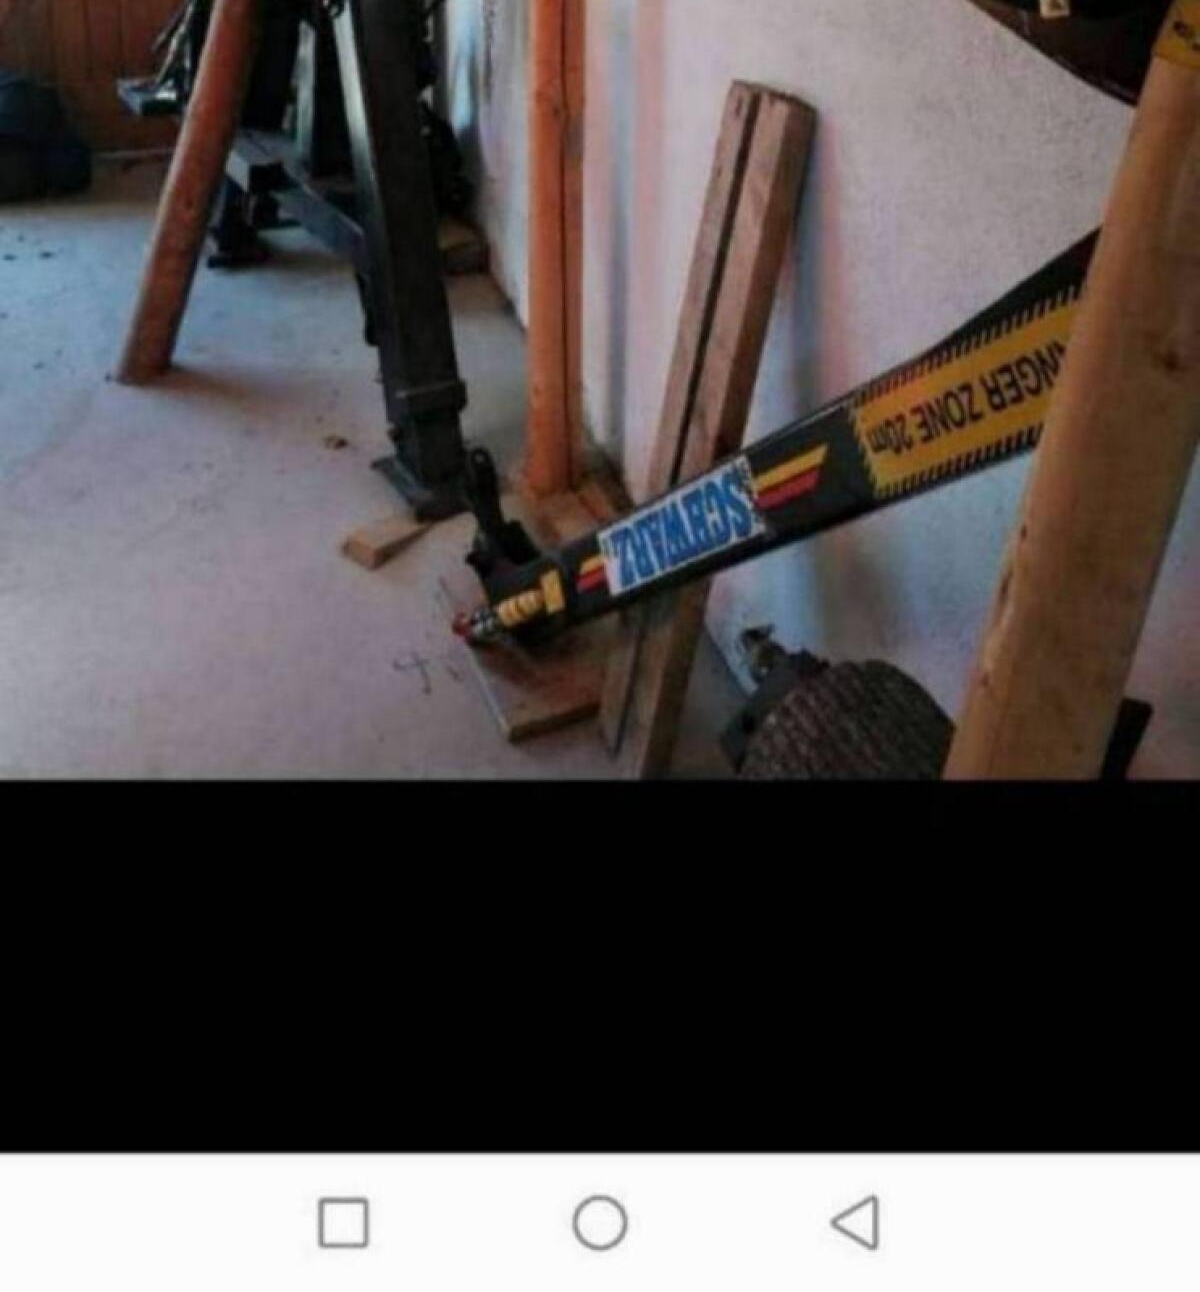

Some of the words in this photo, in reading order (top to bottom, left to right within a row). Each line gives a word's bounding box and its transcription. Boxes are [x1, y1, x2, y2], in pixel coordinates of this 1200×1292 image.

[979, 340, 1066, 412] NGER
[909, 382, 984, 444] ZONE
[609, 465, 754, 589] SCHWARZ
